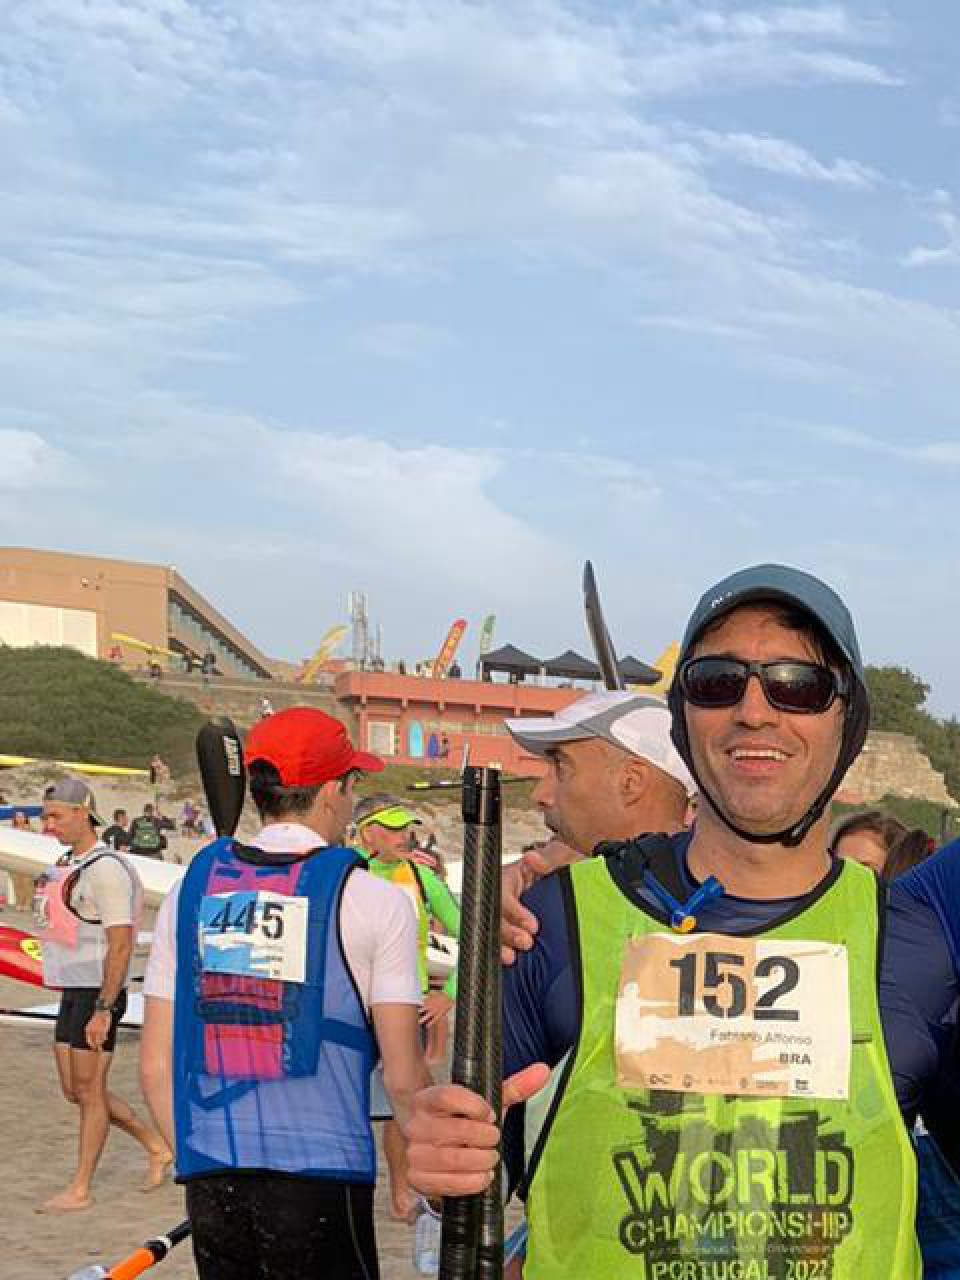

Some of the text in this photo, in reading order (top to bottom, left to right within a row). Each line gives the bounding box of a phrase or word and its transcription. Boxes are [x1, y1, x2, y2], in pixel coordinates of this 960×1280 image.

[209, 901, 285, 940] 445
[669, 952, 800, 1021] 152
[779, 1053, 812, 1065] BRA
[619, 1149, 851, 1213] WORLD
[625, 1209, 849, 1248] CHAMPIONSHIP
